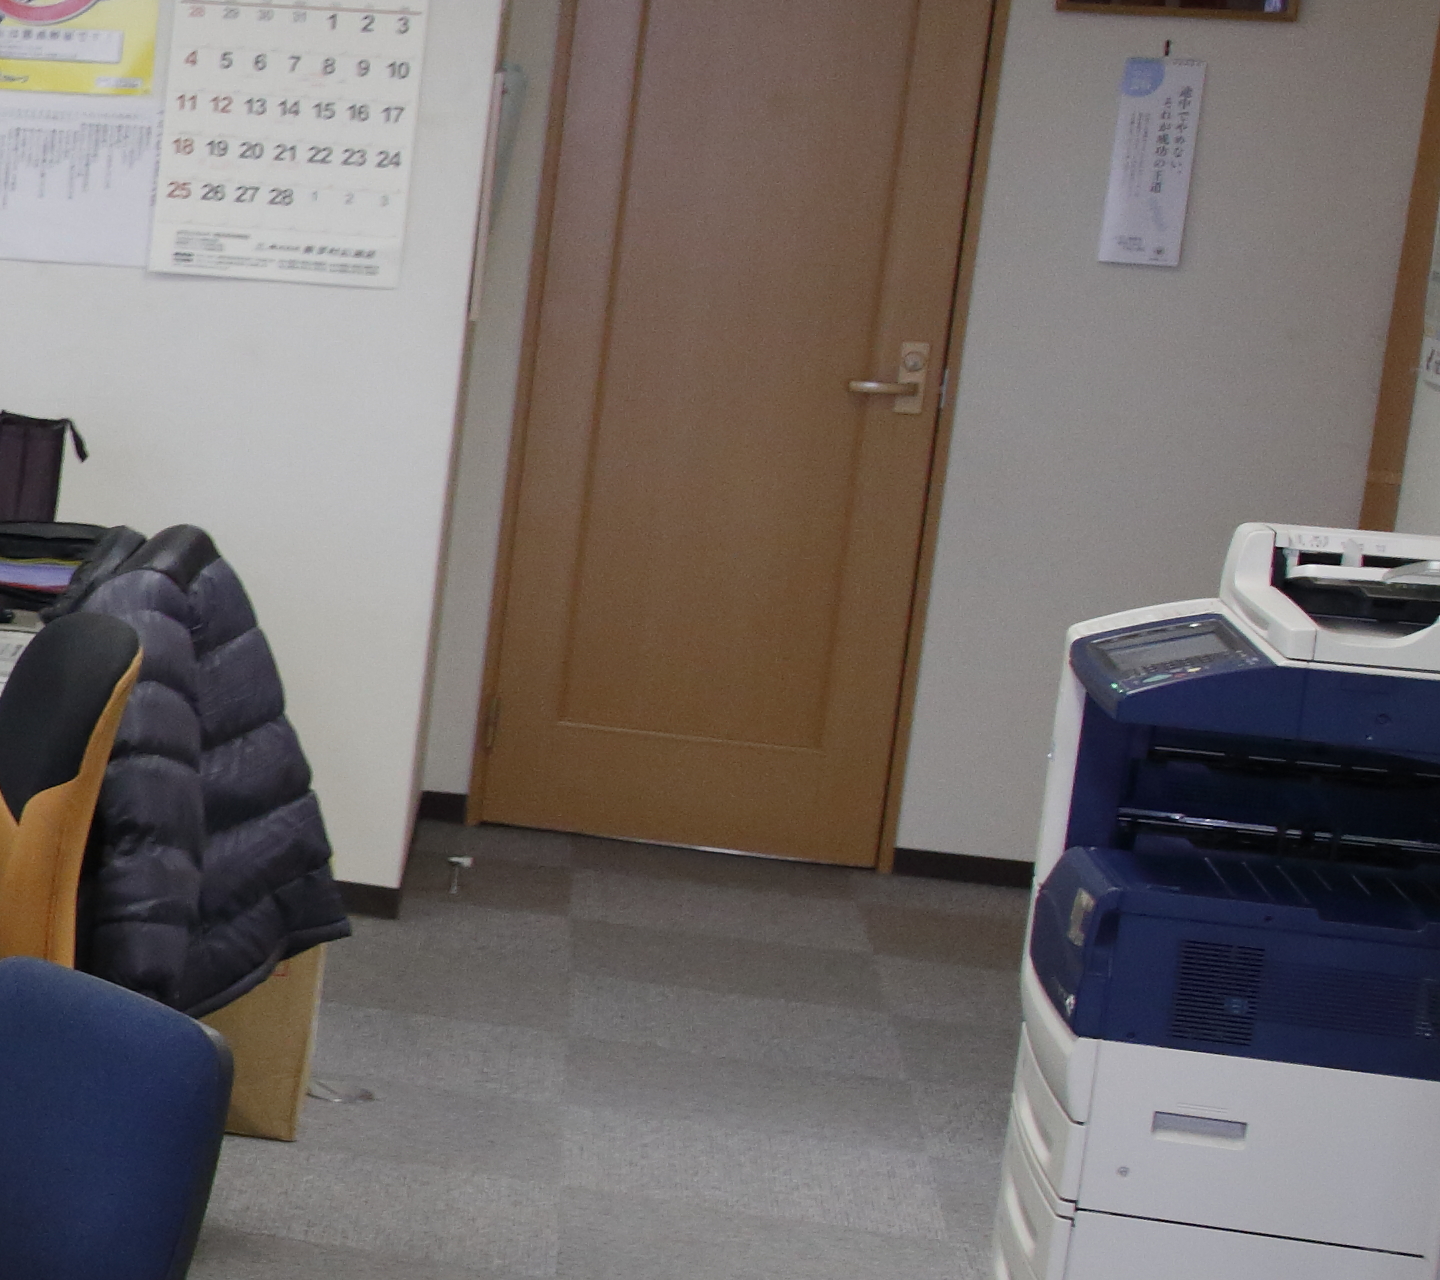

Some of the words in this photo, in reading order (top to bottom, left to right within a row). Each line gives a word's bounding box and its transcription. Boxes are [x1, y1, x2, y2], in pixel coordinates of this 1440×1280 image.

[327, 13, 338, 30] 1
[361, 14, 376, 32] 2
[396, 17, 410, 34] 3
[184, 50, 198, 66] 4
[220, 51, 233, 69] 5
[253, 53, 267, 71] 6
[288, 55, 302, 72] 7
[322, 57, 336, 75] 8
[356, 59, 370, 77] 9
[387, 61, 410, 79] 10
[176, 94, 198, 111] 11
[209, 96, 233, 113] 12
[244, 98, 267, 115] 13
[278, 99, 301, 117] 14
[312, 101, 336, 120] 15
[346, 104, 370, 121] 16
[381, 106, 405, 123] 17
[172, 137, 195, 155] 18
[206, 139, 229, 157] 19
[238, 141, 264, 159] 20
[273, 143, 297, 162] 21
[306, 146, 333, 164] 22
[341, 148, 368, 166] 23
[375, 151, 402, 168] 24
[166, 181, 191, 199] 25
[200, 183, 226, 201] 26
[234, 185, 260, 203] 27
[267, 187, 294, 206] 28
